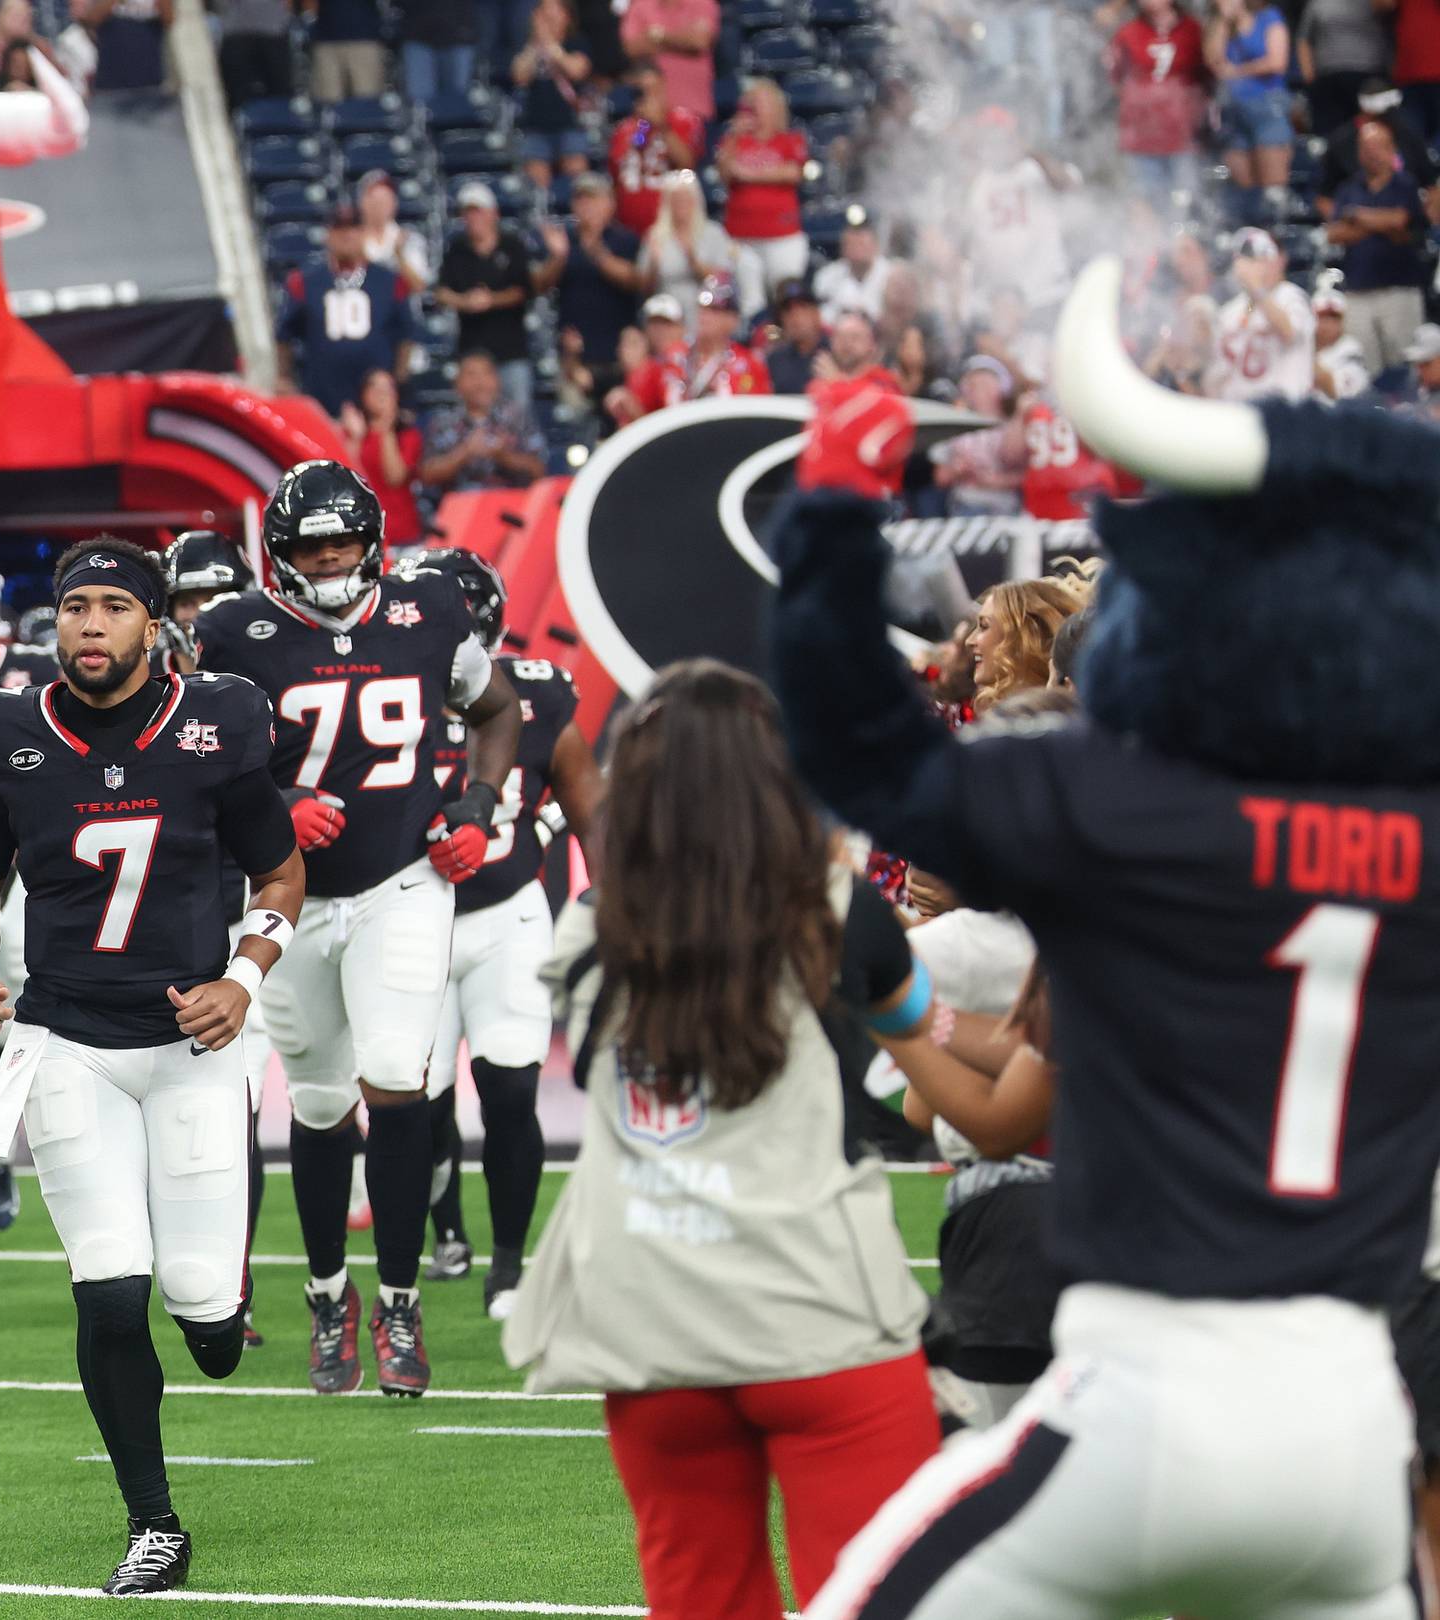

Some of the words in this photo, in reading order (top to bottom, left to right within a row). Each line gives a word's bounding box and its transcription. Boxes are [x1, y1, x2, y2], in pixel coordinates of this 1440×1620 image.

[1146, 43, 1176, 82] 7
[323, 288, 372, 341] 10
[312, 664, 382, 676] TEXANS
[179, 724, 219, 750] 25
[279, 675, 429, 790] 79
[73, 798, 159, 813] TEXANS
[1238, 795, 1422, 903] TORO
[72, 815, 163, 952] 7
[261, 912, 283, 937] 7
[1265, 902, 1381, 1197] 1
[627, 1080, 700, 1133] NL
